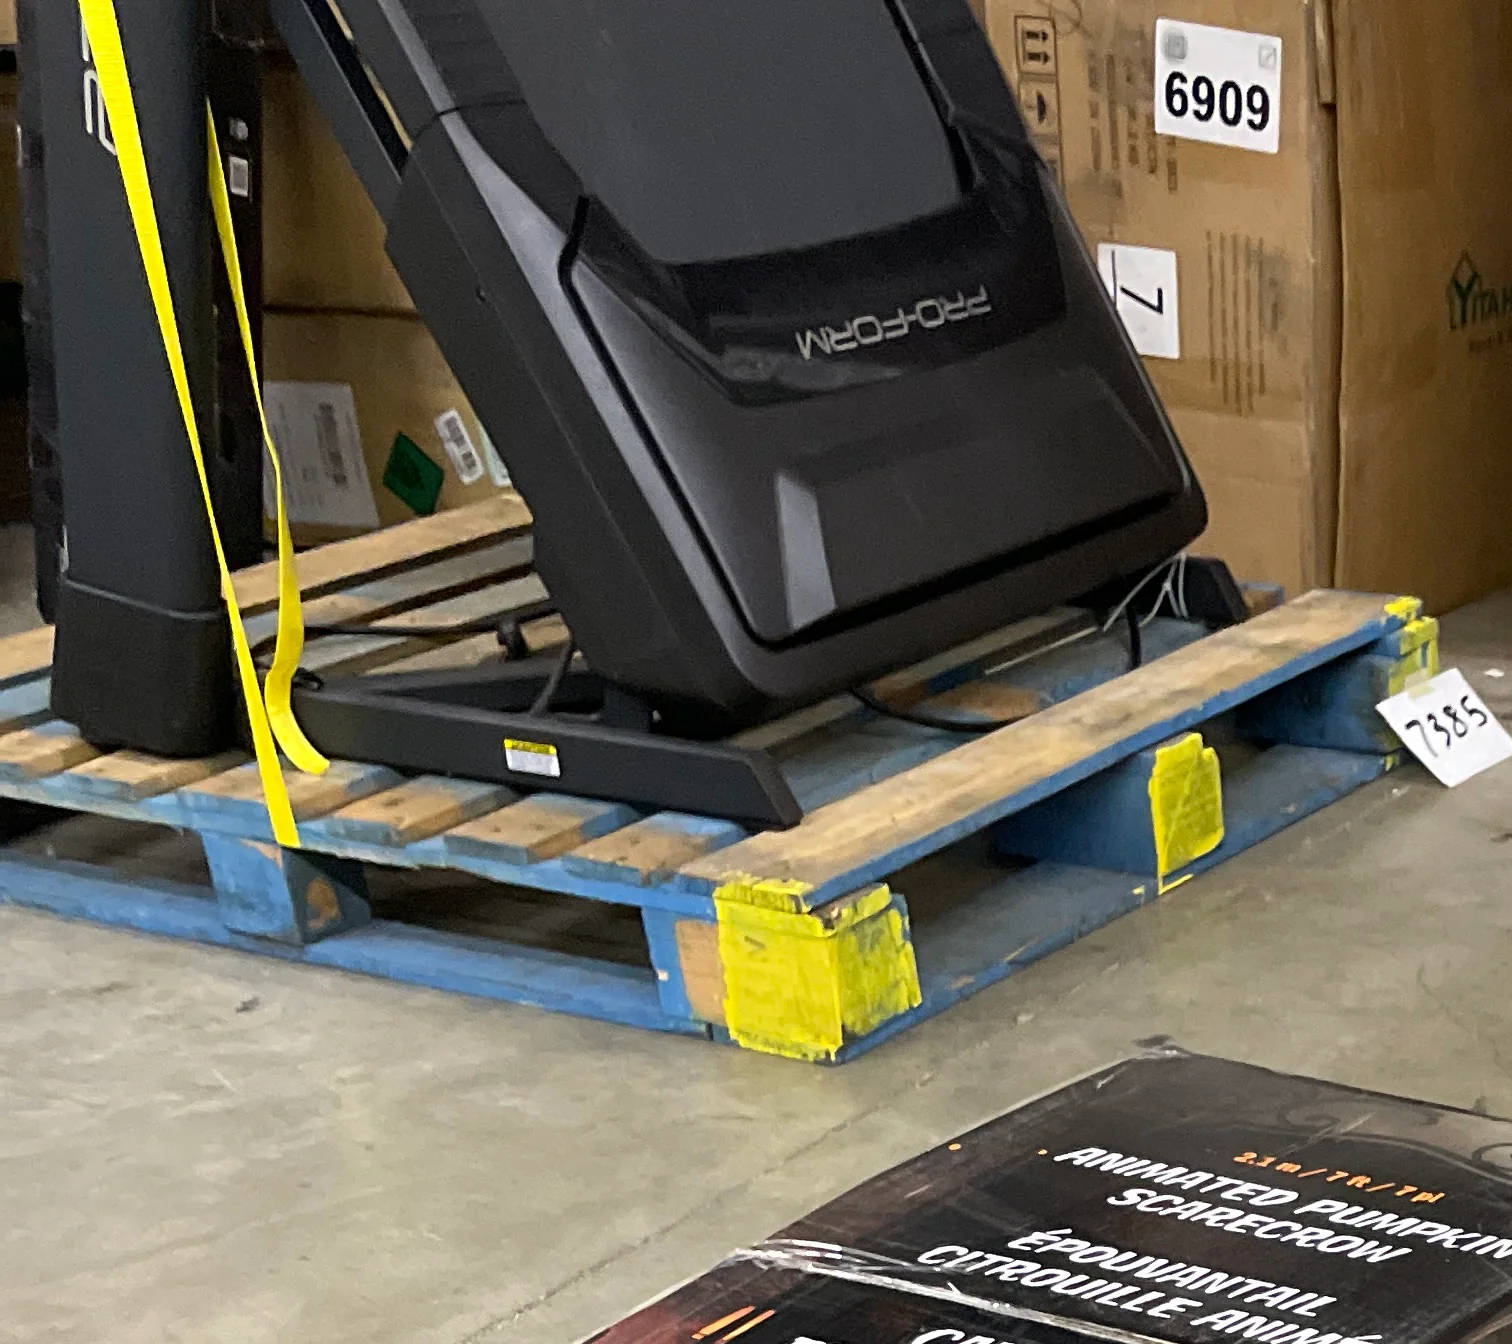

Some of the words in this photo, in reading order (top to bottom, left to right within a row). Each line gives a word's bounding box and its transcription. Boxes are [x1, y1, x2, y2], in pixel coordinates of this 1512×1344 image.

[1165, 71, 1270, 131] 6909
[795, 284, 992, 360] PRO-FORM
[1405, 695, 1487, 757] 7385
[1054, 1148, 1298, 1205] ANIMATED
[1107, 1189, 1412, 1262] SCARECROW
[918, 1246, 1203, 1318] CITROUILLE
[1008, 1229, 1337, 1316] ÉPOUVANTAIL
